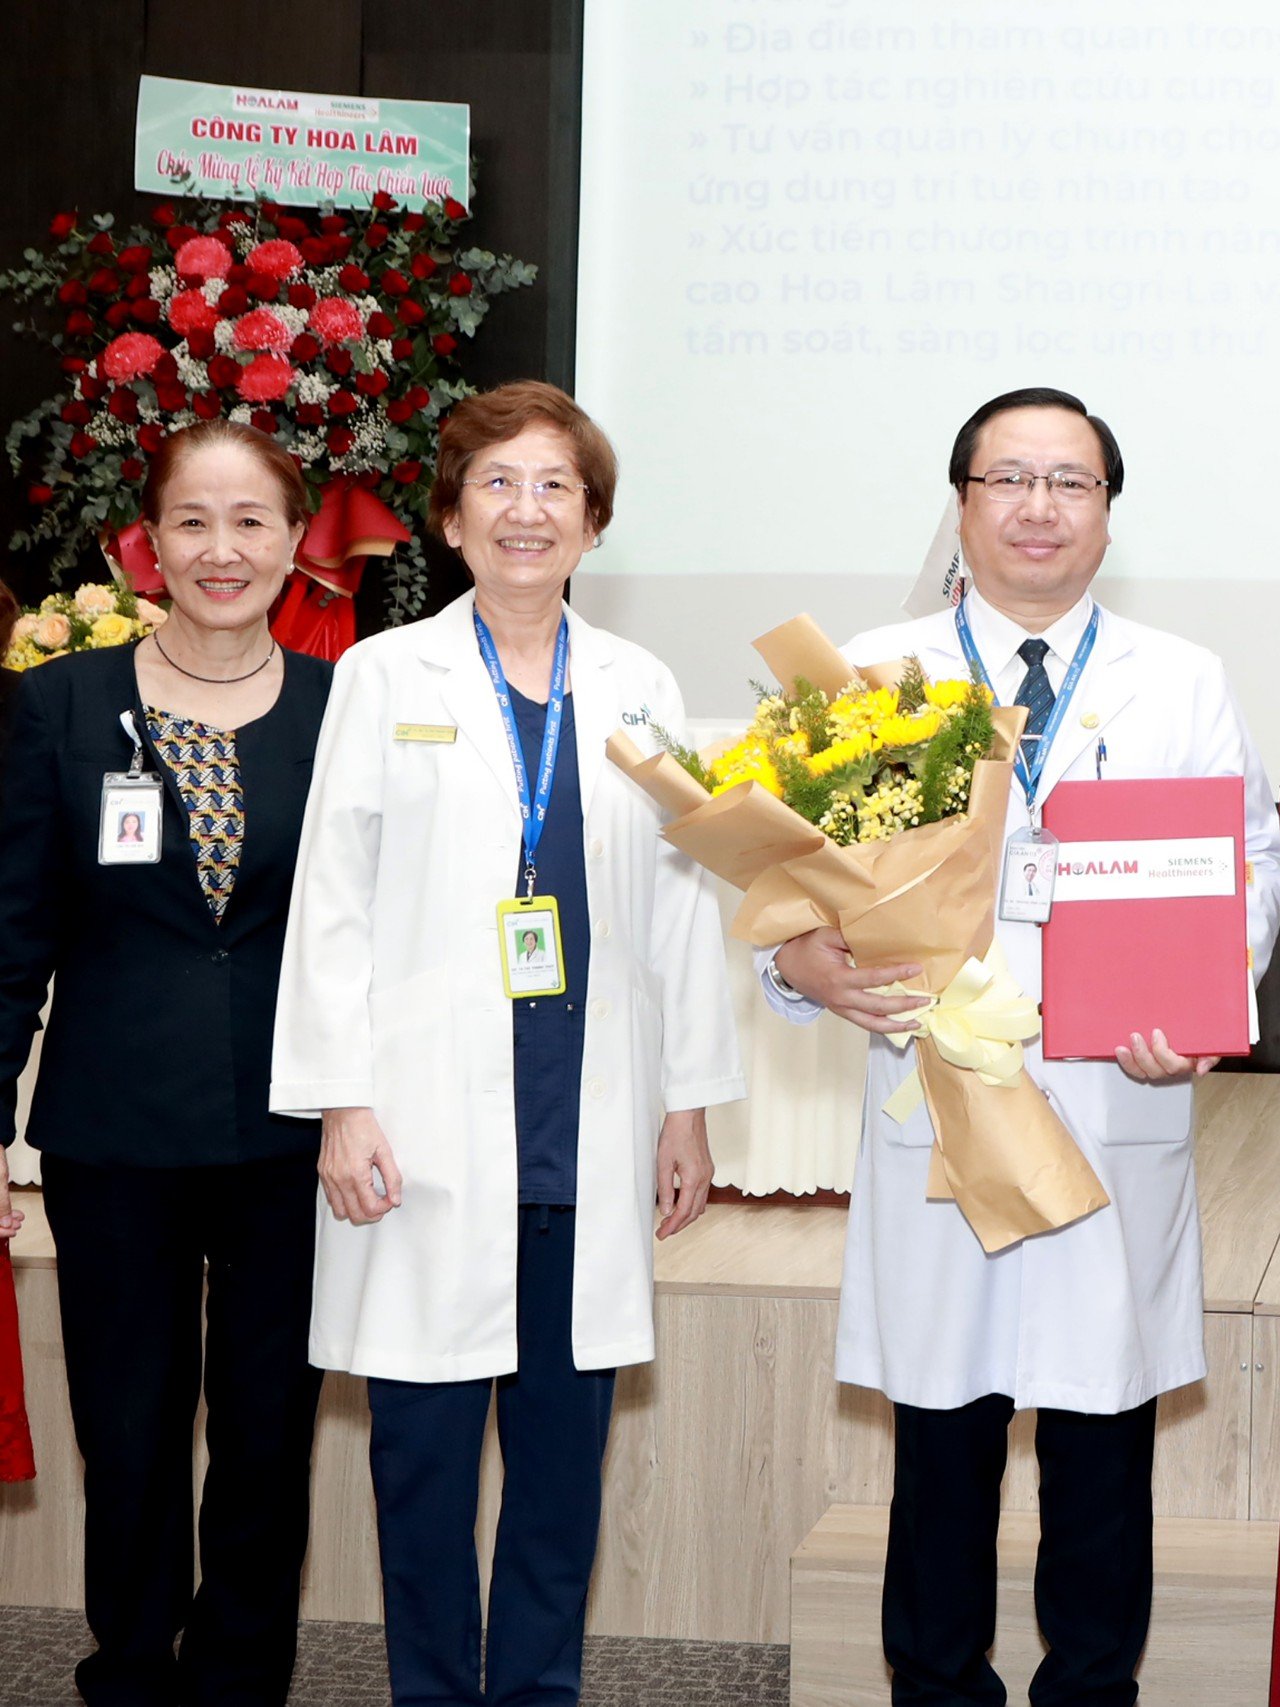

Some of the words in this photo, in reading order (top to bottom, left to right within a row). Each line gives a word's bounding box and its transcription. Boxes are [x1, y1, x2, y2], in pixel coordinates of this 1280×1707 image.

[192, 115, 262, 142] CÔNG
[271, 125, 298, 145] TY
[307, 129, 356, 150] HOA
[365, 129, 417, 155] LÂM
[621, 711, 647, 726] CIH
[1057, 860, 1139, 876] HOALAM
[1167, 856, 1214, 866] SIEMENS
